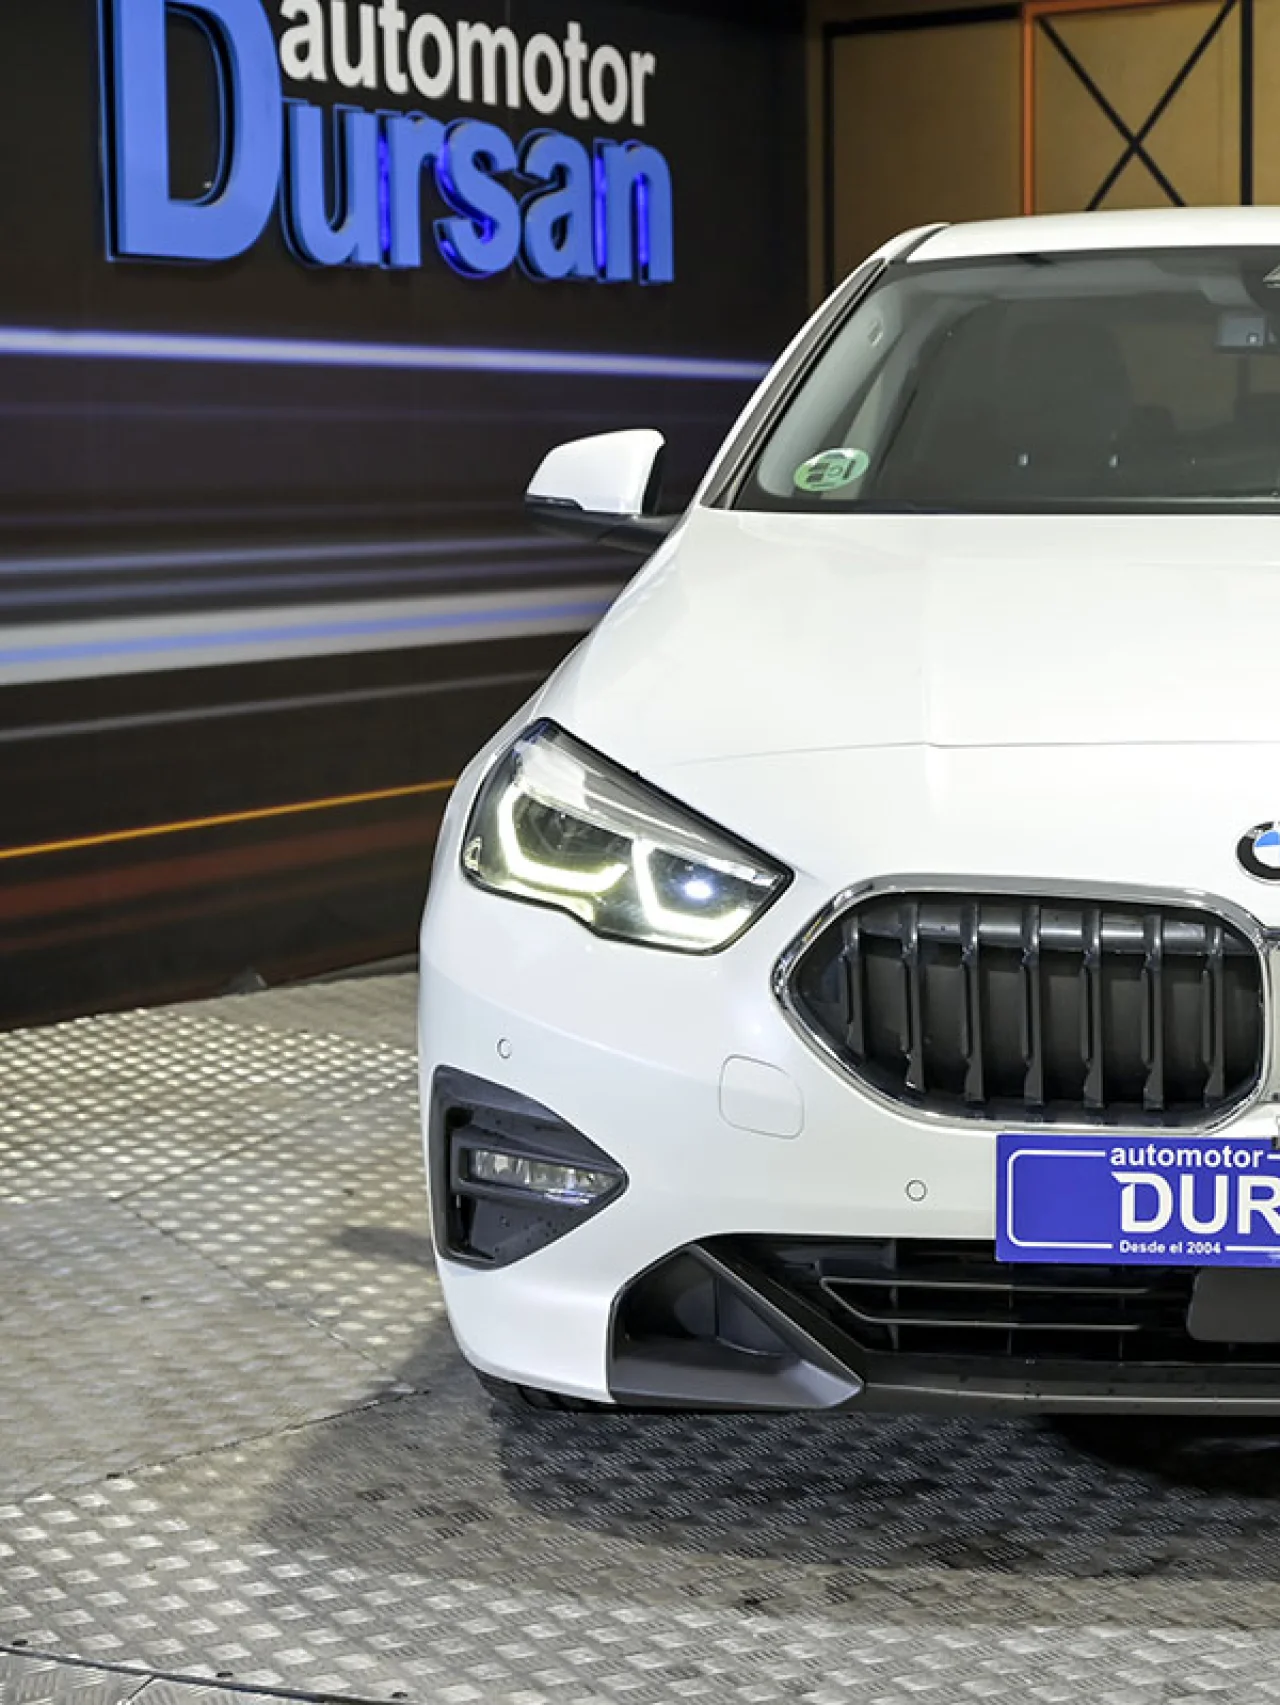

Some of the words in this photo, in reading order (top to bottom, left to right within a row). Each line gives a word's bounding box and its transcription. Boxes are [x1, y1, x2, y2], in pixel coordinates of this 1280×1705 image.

[279, 0, 655, 125] automotor
[104, 0, 674, 283] Dursan
[1110, 1143, 1264, 1168] automotor
[1119, 1240, 1166, 1253] Desde
[1169, 1241, 1183, 1253] el
[1186, 1241, 1221, 1254] 2004
